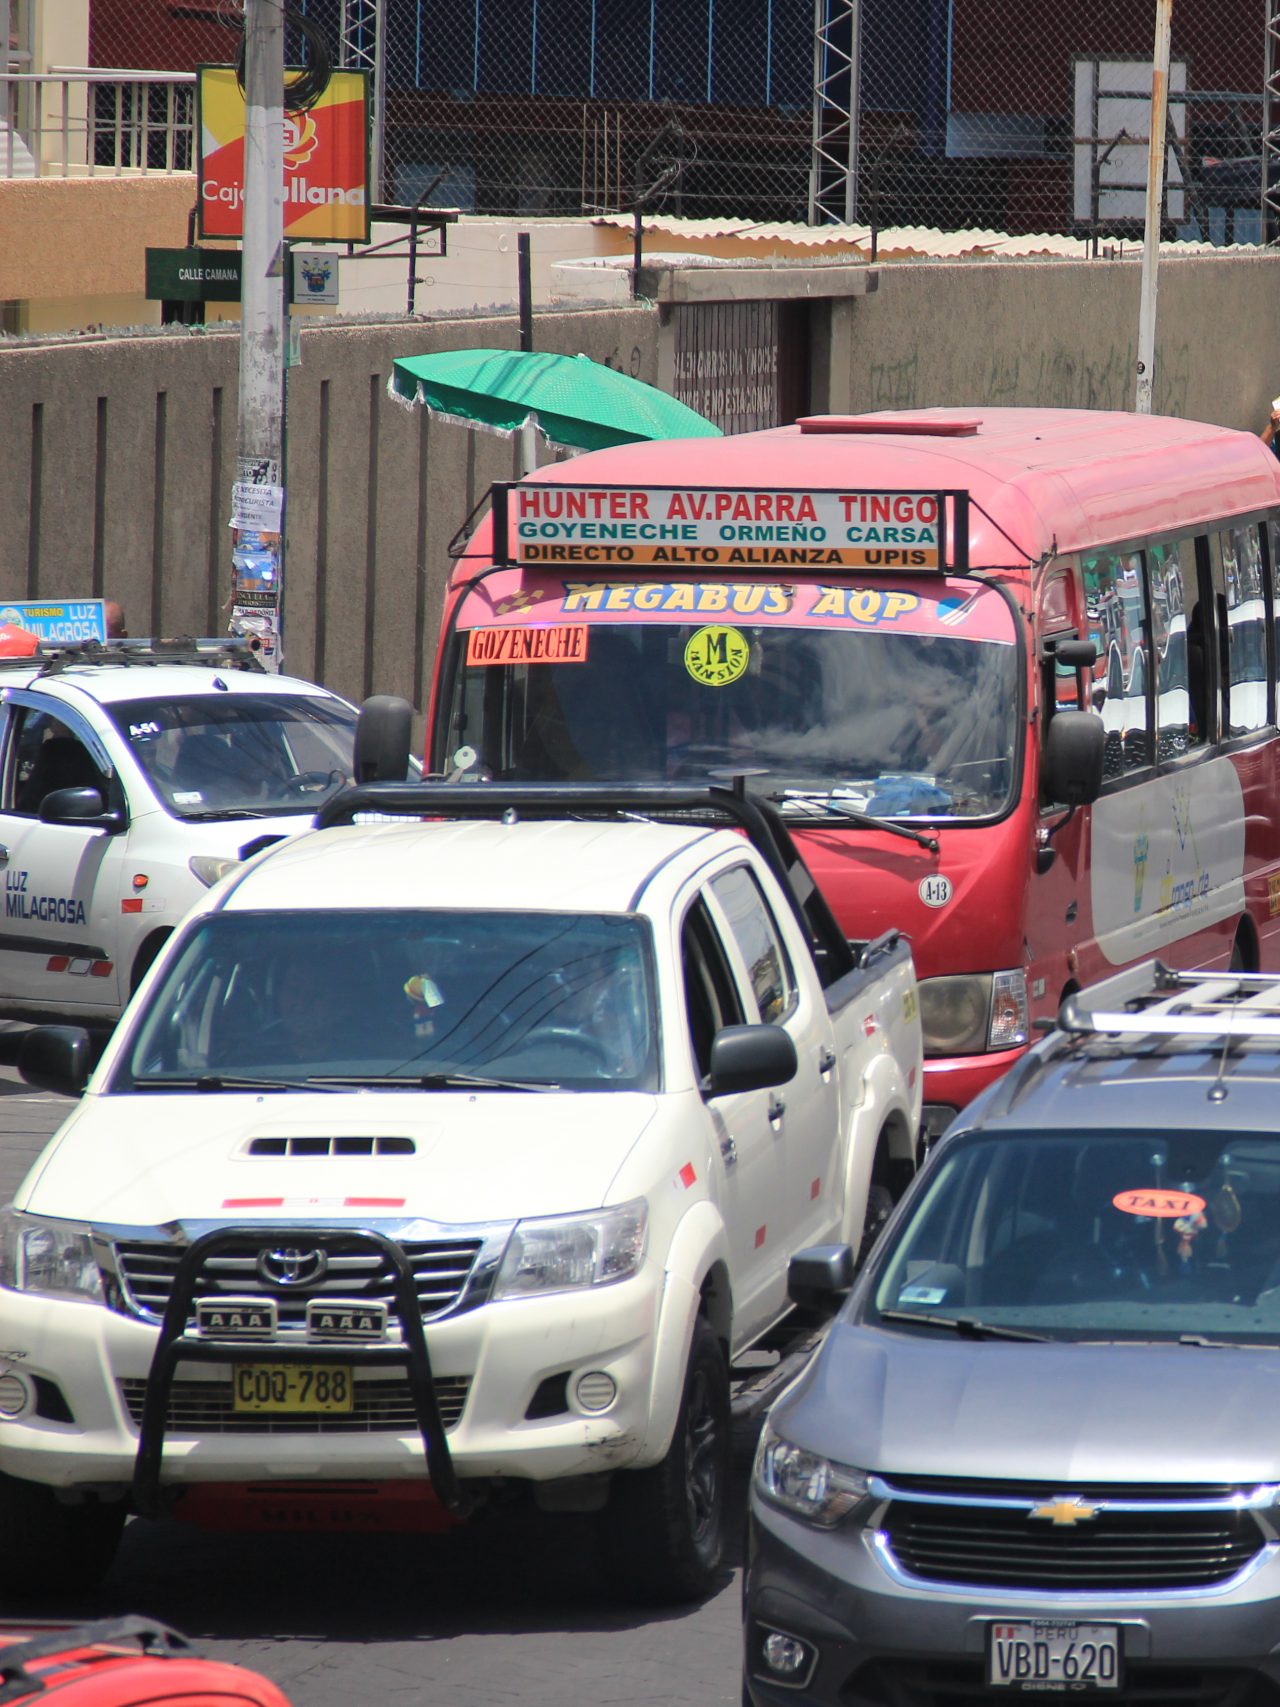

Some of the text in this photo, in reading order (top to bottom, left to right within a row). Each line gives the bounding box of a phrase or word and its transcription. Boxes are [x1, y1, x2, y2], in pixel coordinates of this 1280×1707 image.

[283, 176, 364, 205] llana
[179, 268, 238, 281] CALLE CAMANA
[519, 490, 650, 520] HUNTER
[838, 495, 938, 524] TINGO
[518, 521, 935, 544] GOYENECHE ORMEÑO CARSA
[524, 544, 927, 565] DIRECTO ALTO ALIANZA UPIS
[22, 606, 64, 618] TURISMO
[68, 604, 97, 620] LUZ
[562, 582, 920, 624] MEGABUS AQP
[25, 621, 101, 641] MILAGROSA
[472, 627, 584, 660] GOYENECHE
[705, 632, 728, 665] M
[690, 648, 744, 681] MANSION
[6, 870, 28, 892] LUZ
[6, 893, 87, 926] MILAGROSA
[1129, 1195, 1192, 1212] TAXI
[1034, 1626, 1079, 1641] PERU
[998, 1642, 1116, 1680] VBD-620
